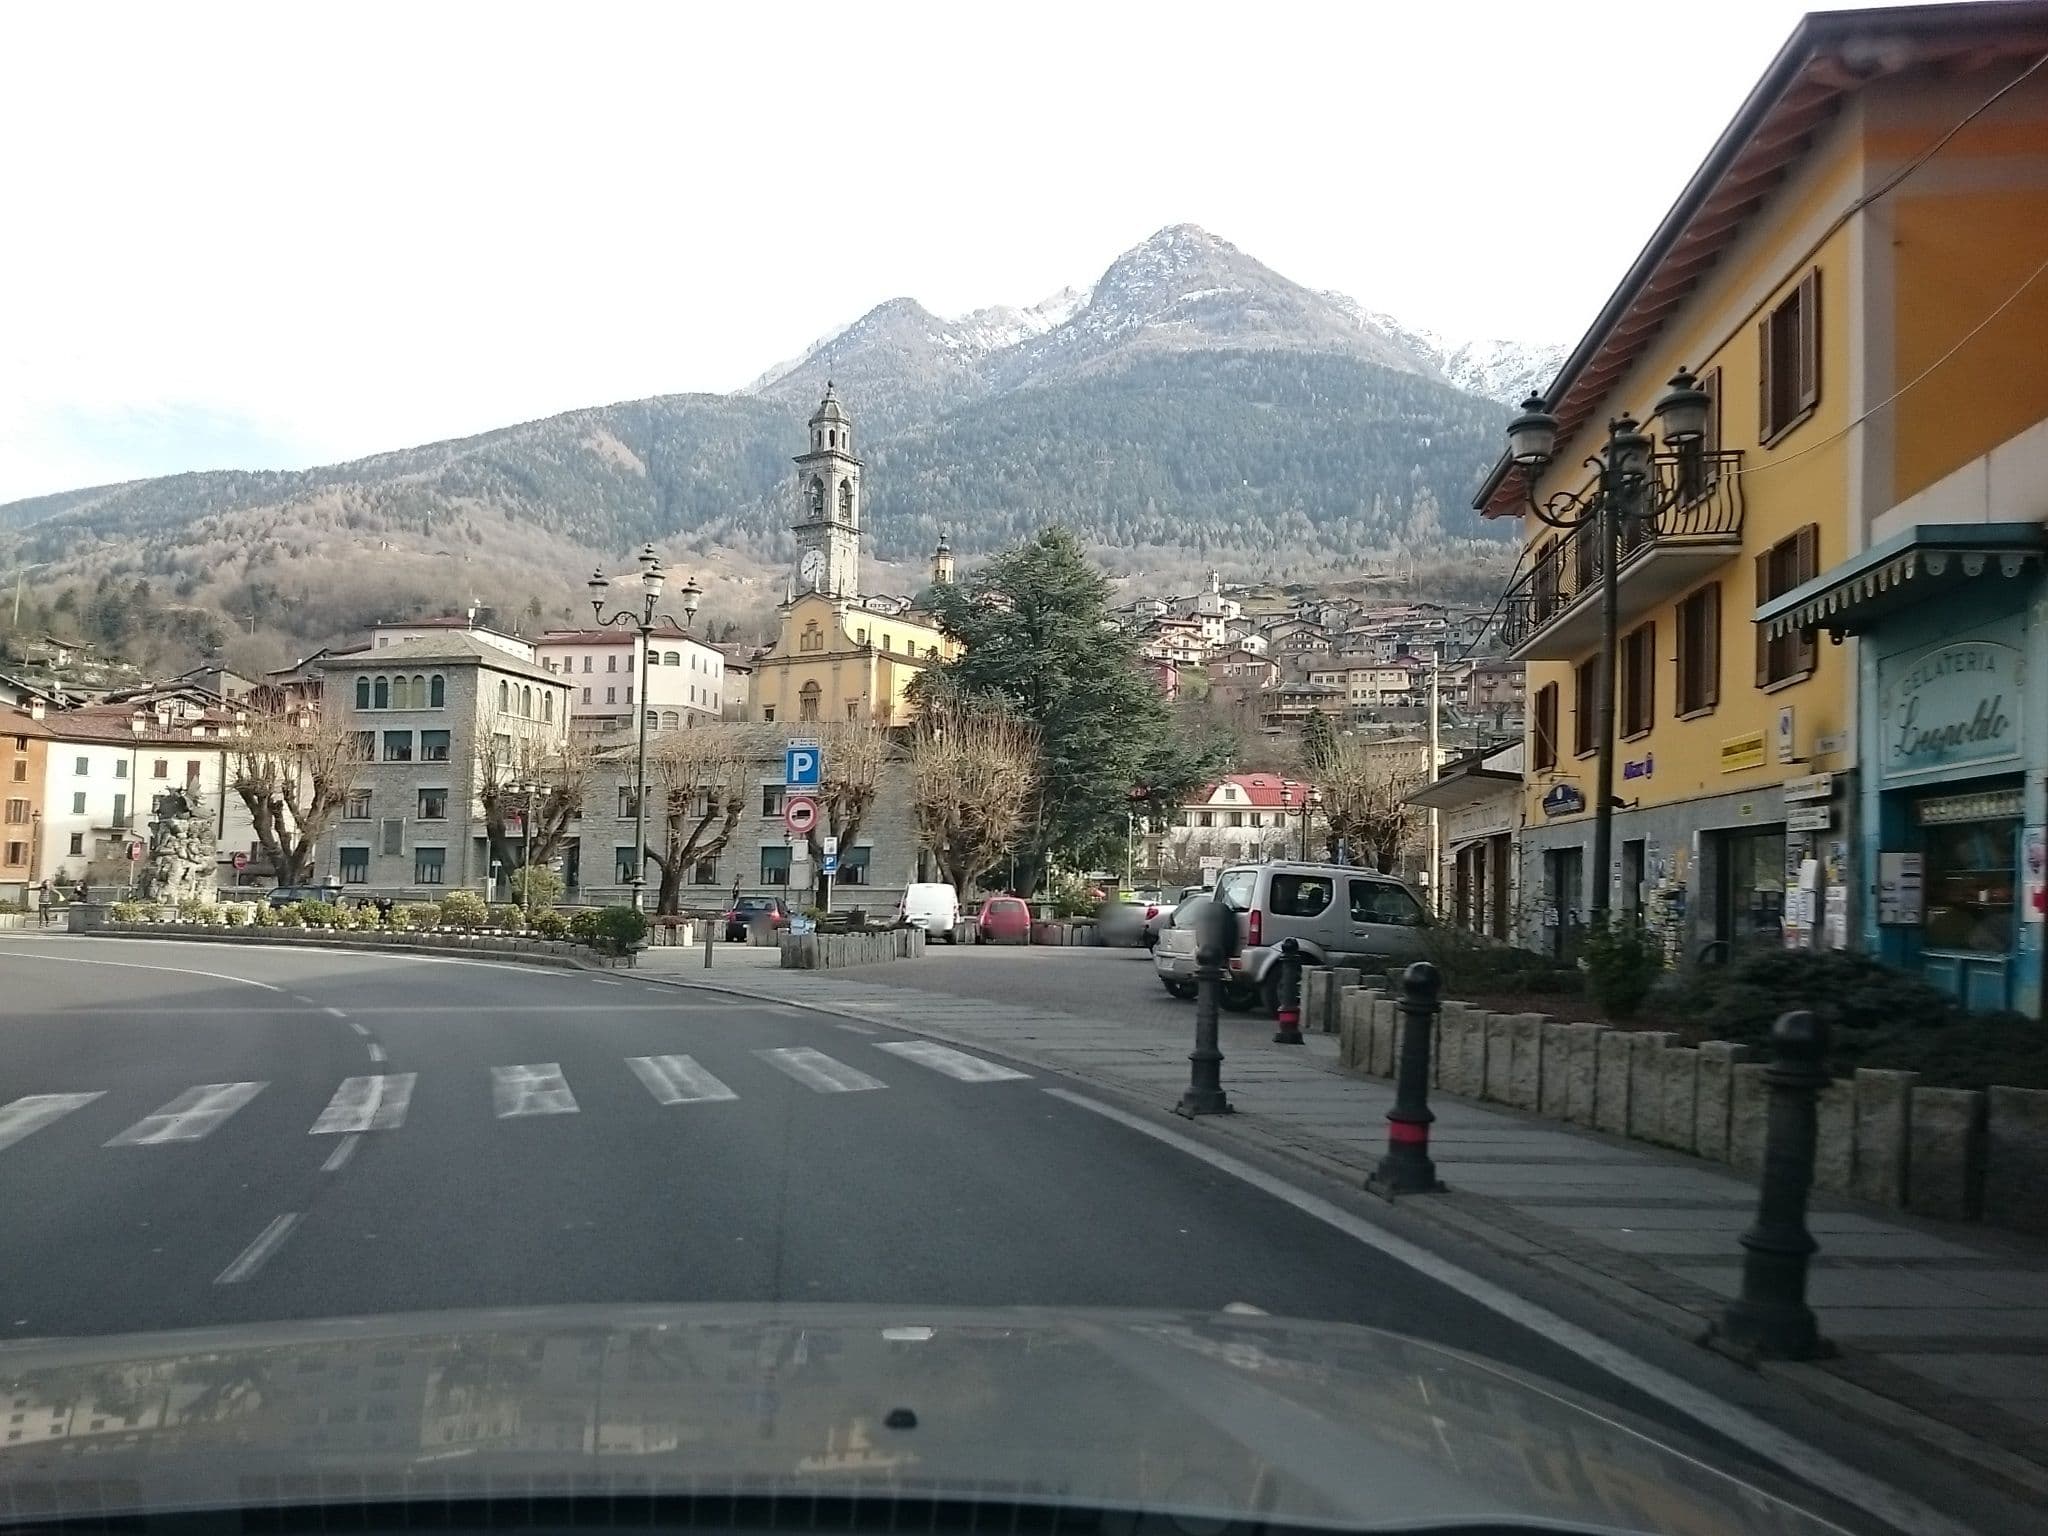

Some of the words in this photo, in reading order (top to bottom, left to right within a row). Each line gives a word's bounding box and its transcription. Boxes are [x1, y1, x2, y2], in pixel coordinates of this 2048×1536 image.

[1902, 651, 1997, 697] GELATERIA
[792, 752, 813, 781] P
[825, 856, 834, 865] P
